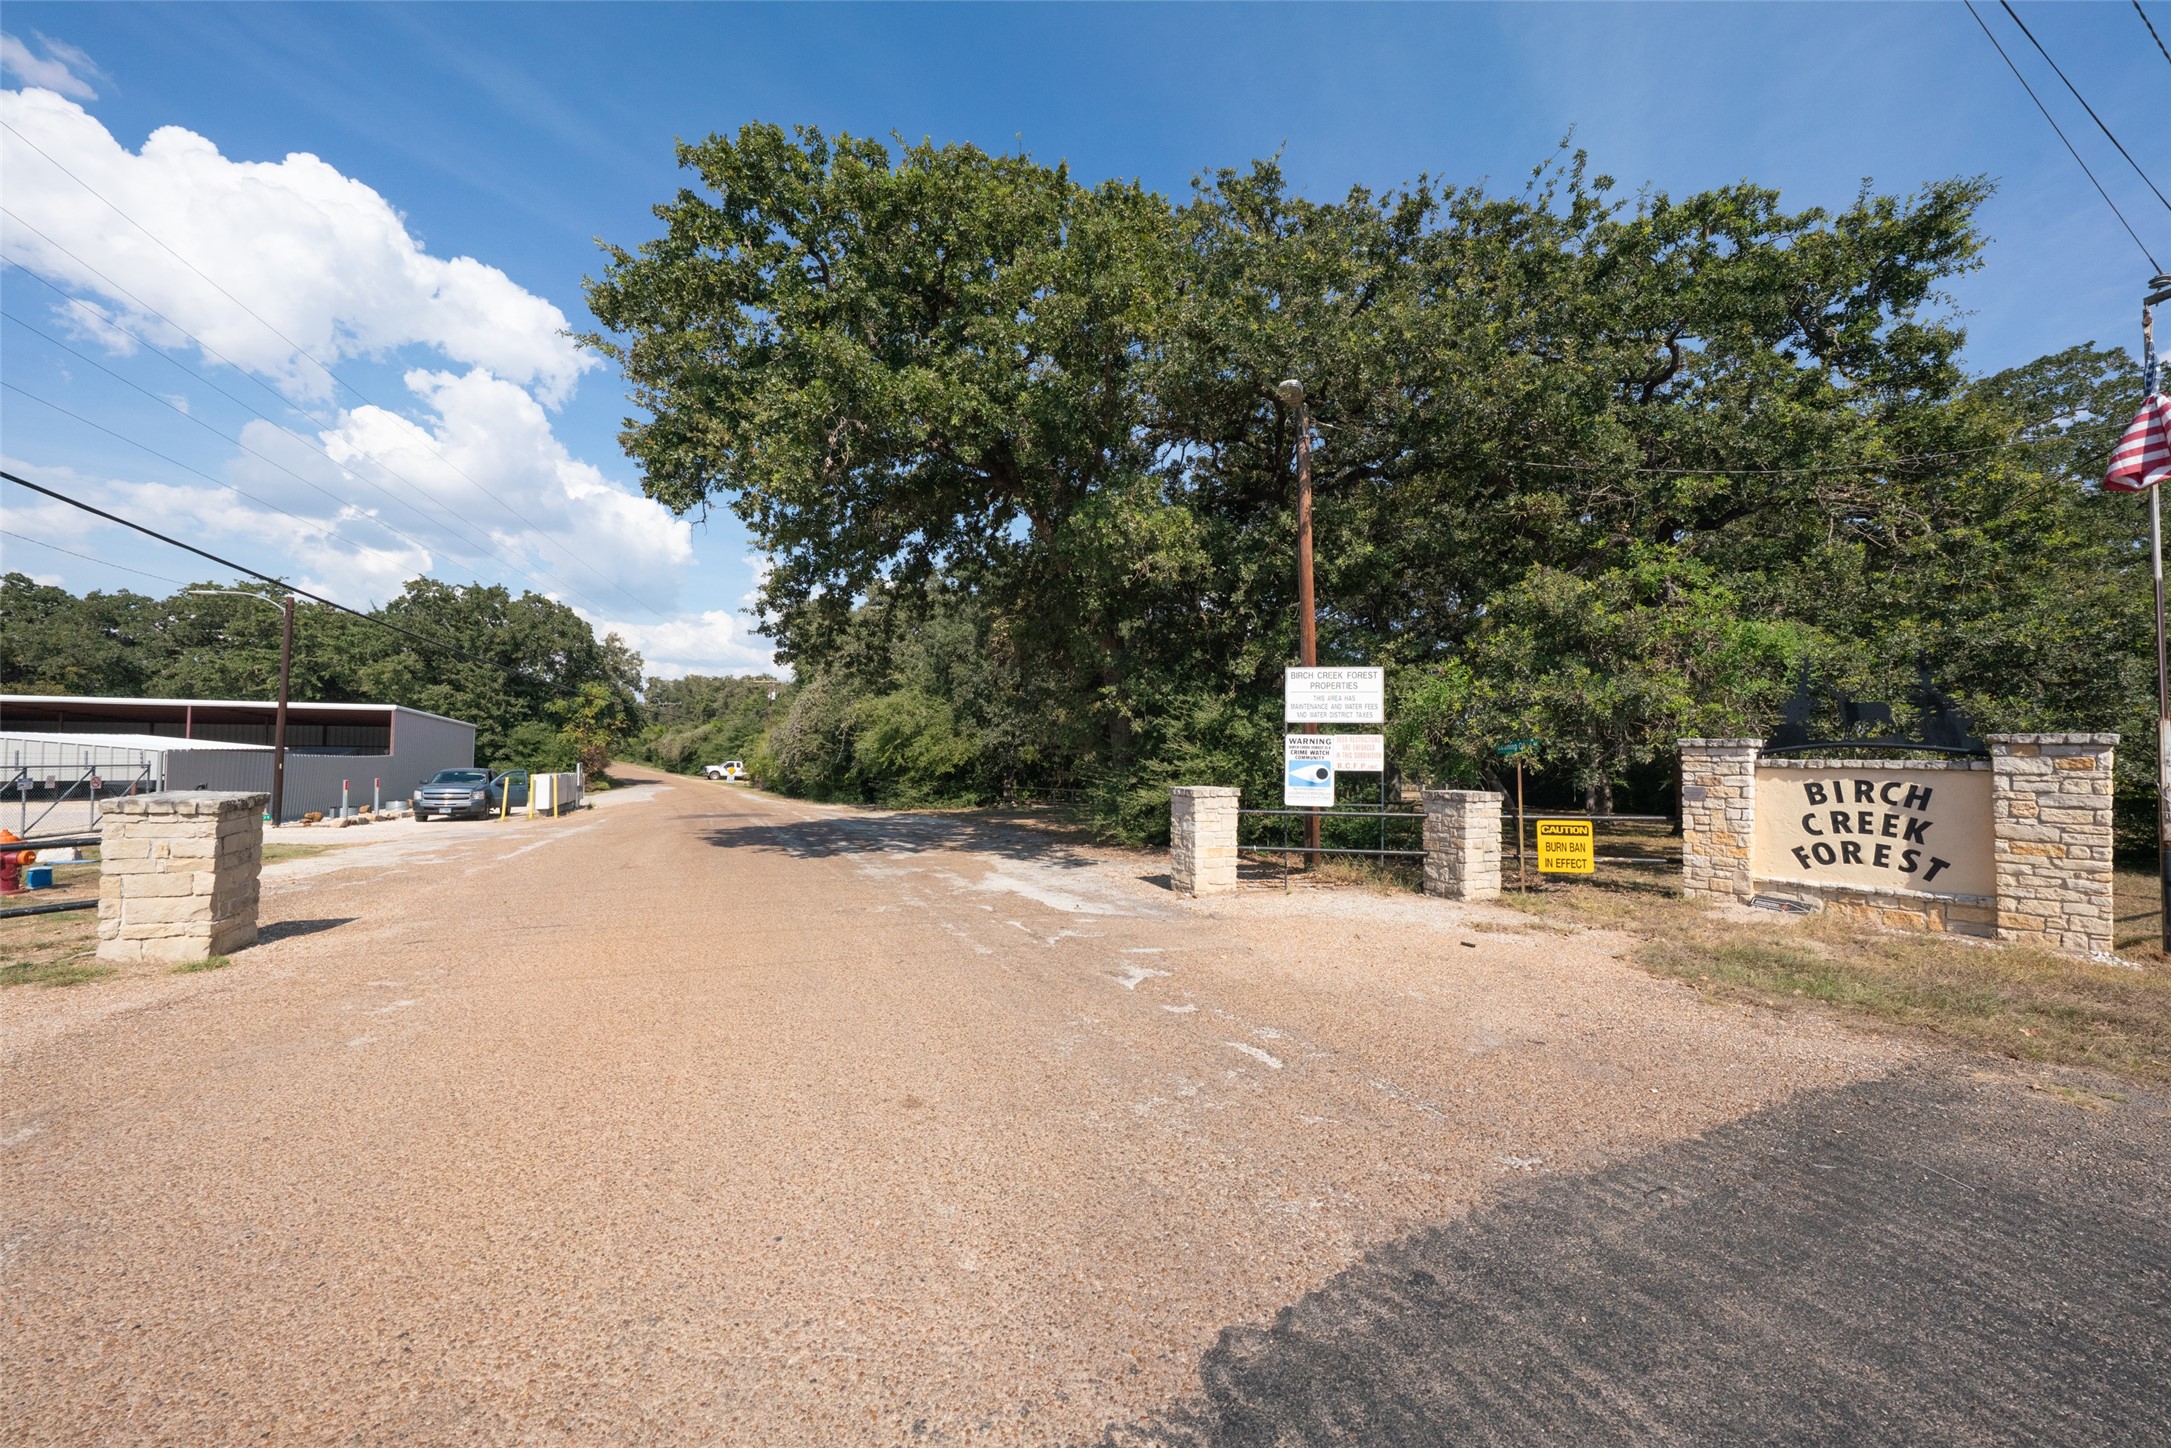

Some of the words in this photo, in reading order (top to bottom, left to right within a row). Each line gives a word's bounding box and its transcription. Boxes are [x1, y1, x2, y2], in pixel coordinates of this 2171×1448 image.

[1290, 671, 1314, 680] BIRCH
[1317, 671, 1343, 680] CREEK
[1346, 671, 1378, 680] FOREST
[1310, 681, 1358, 690] PROPERTIES
[1288, 737, 1332, 746] WARNING
[1802, 779, 1934, 812] BIRCH
[1541, 825, 1588, 835] CAUTION
[1801, 810, 1934, 846] CREEK
[1545, 841, 1567, 853] BURN
[1569, 842, 1586, 853] BAN
[1544, 858, 1553, 868] IN
[1555, 858, 1588, 869] EFFECT
[1790, 840, 1952, 883] FOREST
